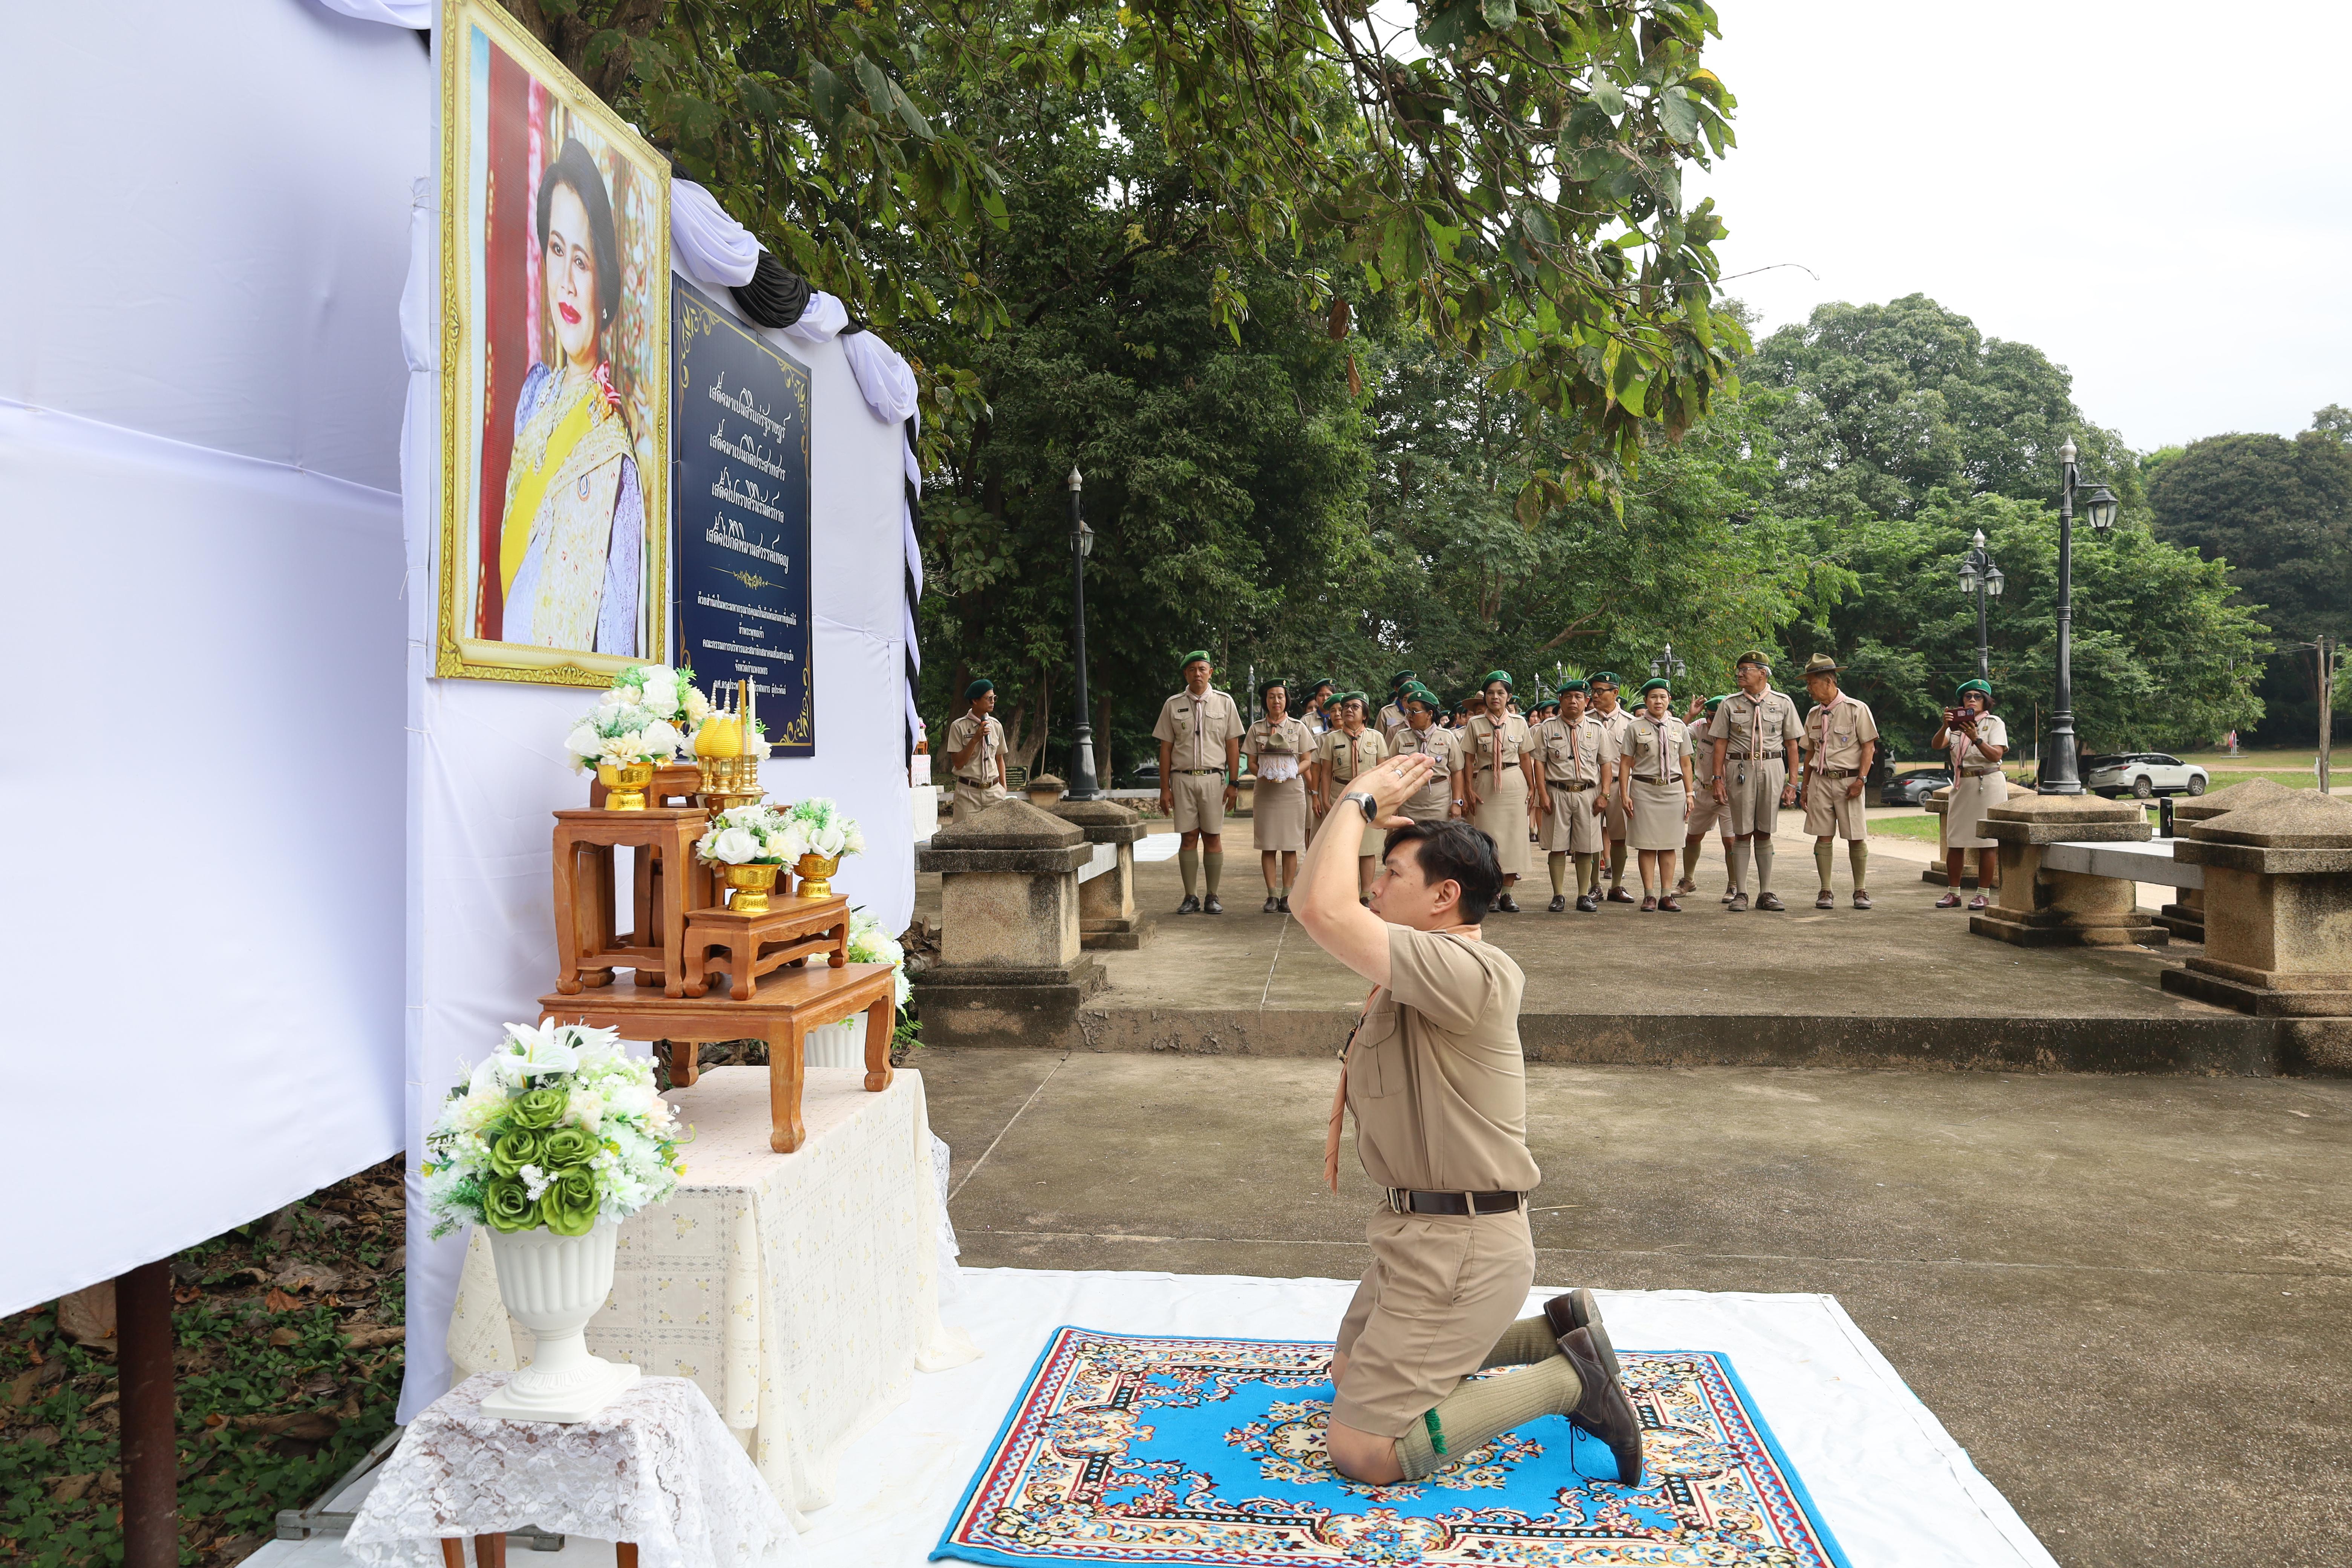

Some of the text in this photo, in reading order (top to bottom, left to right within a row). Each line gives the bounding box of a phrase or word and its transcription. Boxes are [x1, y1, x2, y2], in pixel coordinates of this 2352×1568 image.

[738, 622, 764, 641] ข้าพระพุทธเจ้า
[735, 659, 768, 675] จังหวัดกำแพงเพชร
[771, 683, 786, 697] ผู้ประพันธ์
